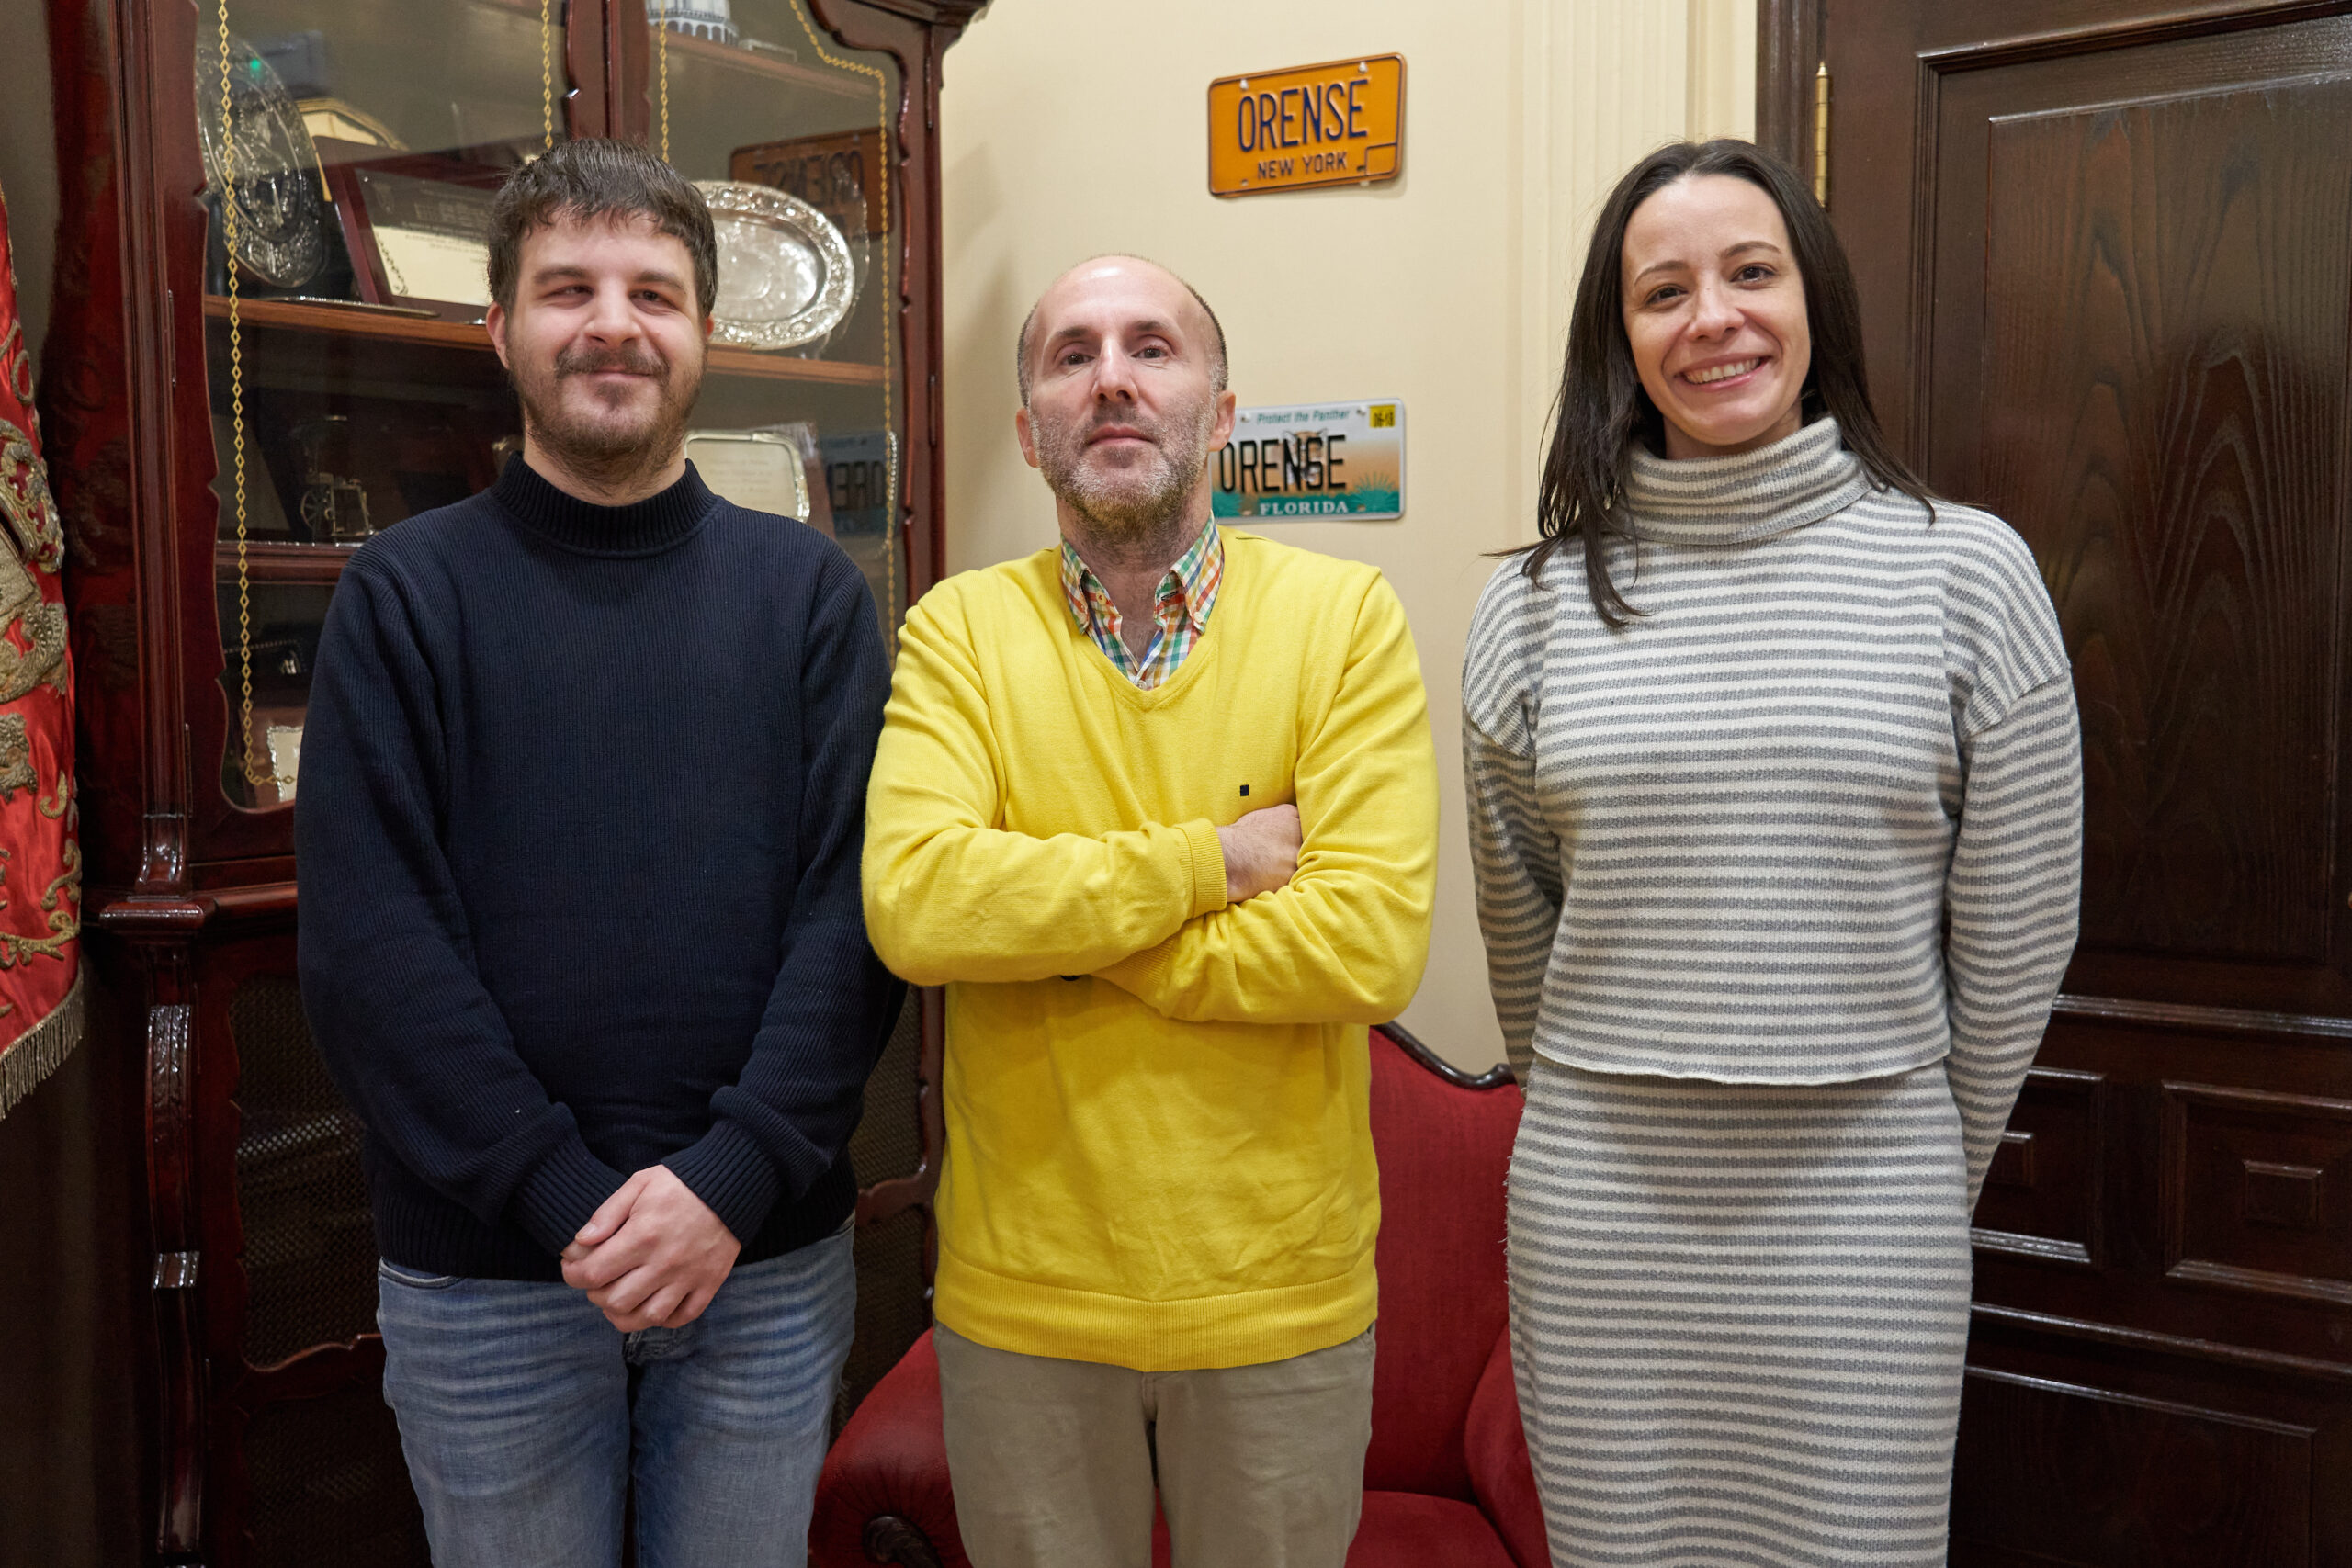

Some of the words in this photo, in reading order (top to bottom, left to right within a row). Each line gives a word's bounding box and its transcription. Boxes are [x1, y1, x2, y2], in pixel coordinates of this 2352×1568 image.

[1238, 79, 1369, 152] ORENSE
[1257, 159, 1295, 179] NEW
[1303, 152, 1348, 174] YORK
[1257, 412, 1292, 424] Protect
[1294, 410, 1309, 423] the
[1313, 409, 1350, 422] Panther
[1219, 434, 1346, 494] ORENSE
[1260, 501, 1349, 516] FLORIDA
